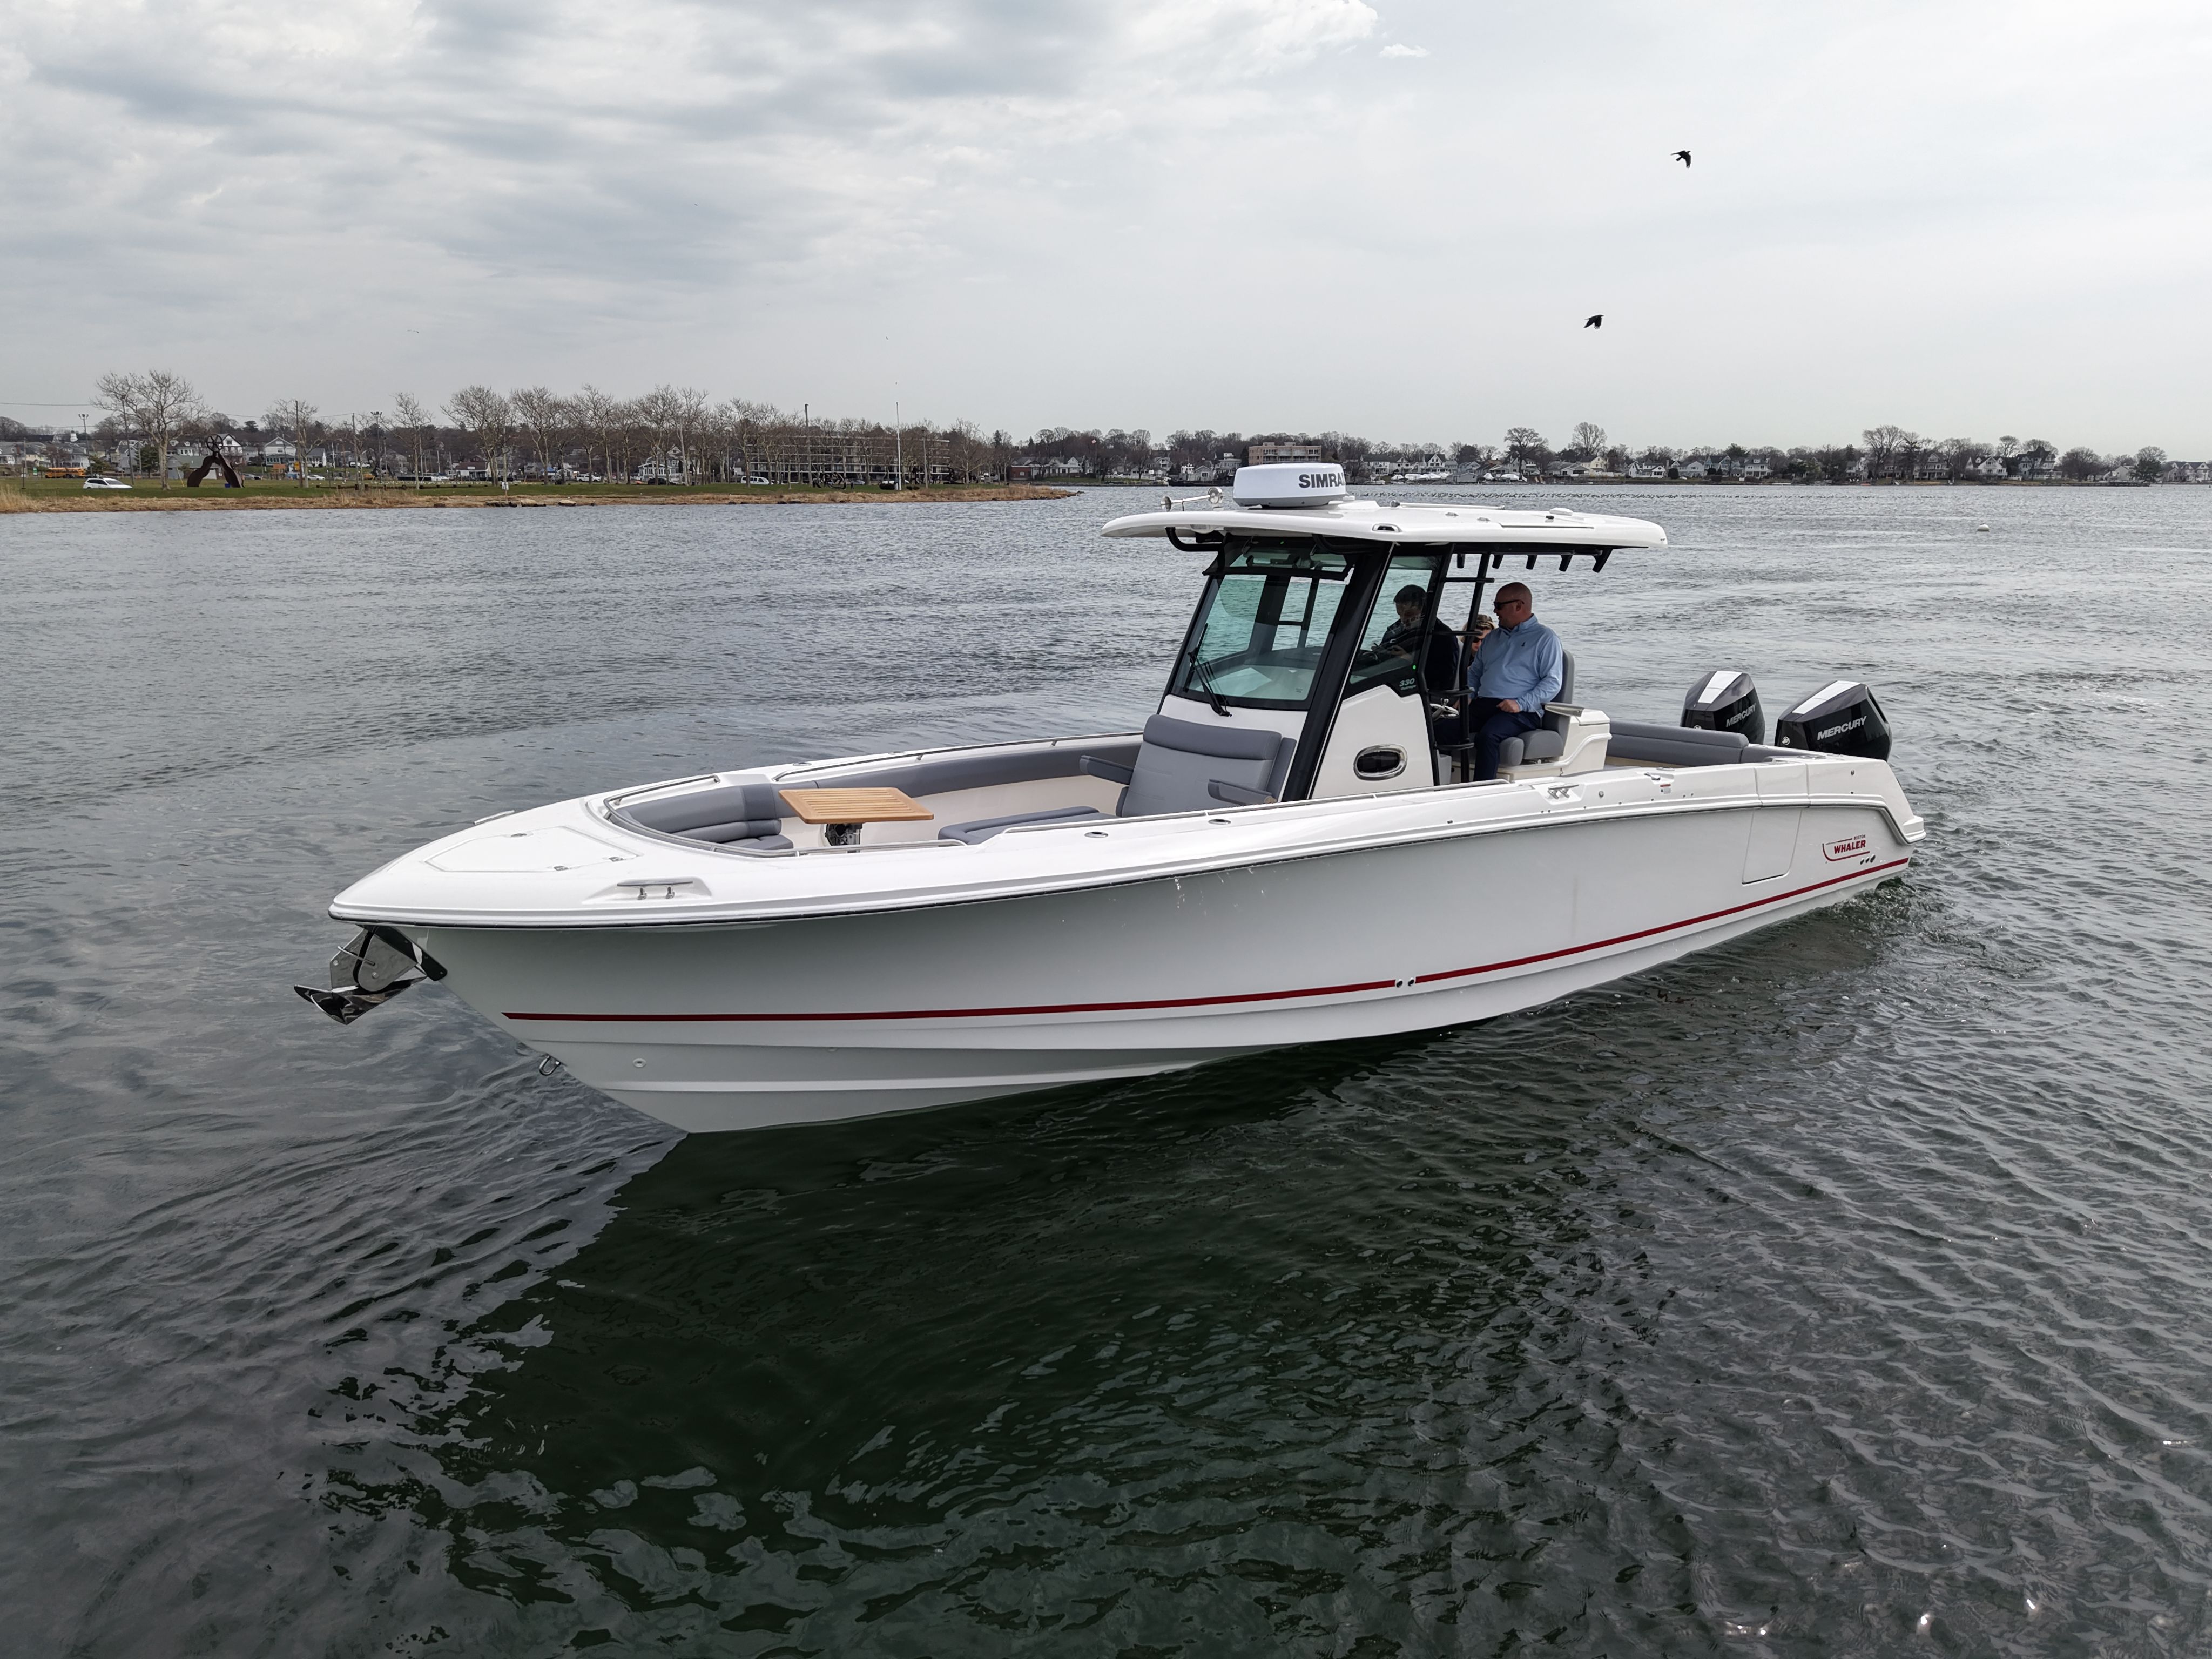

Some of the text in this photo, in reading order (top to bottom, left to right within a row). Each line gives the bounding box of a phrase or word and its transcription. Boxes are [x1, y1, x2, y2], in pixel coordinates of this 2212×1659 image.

[1726, 703, 1756, 727] MERCURY
[1817, 716, 1867, 740] MERCURY
[1834, 840, 1866, 854] WHALER
